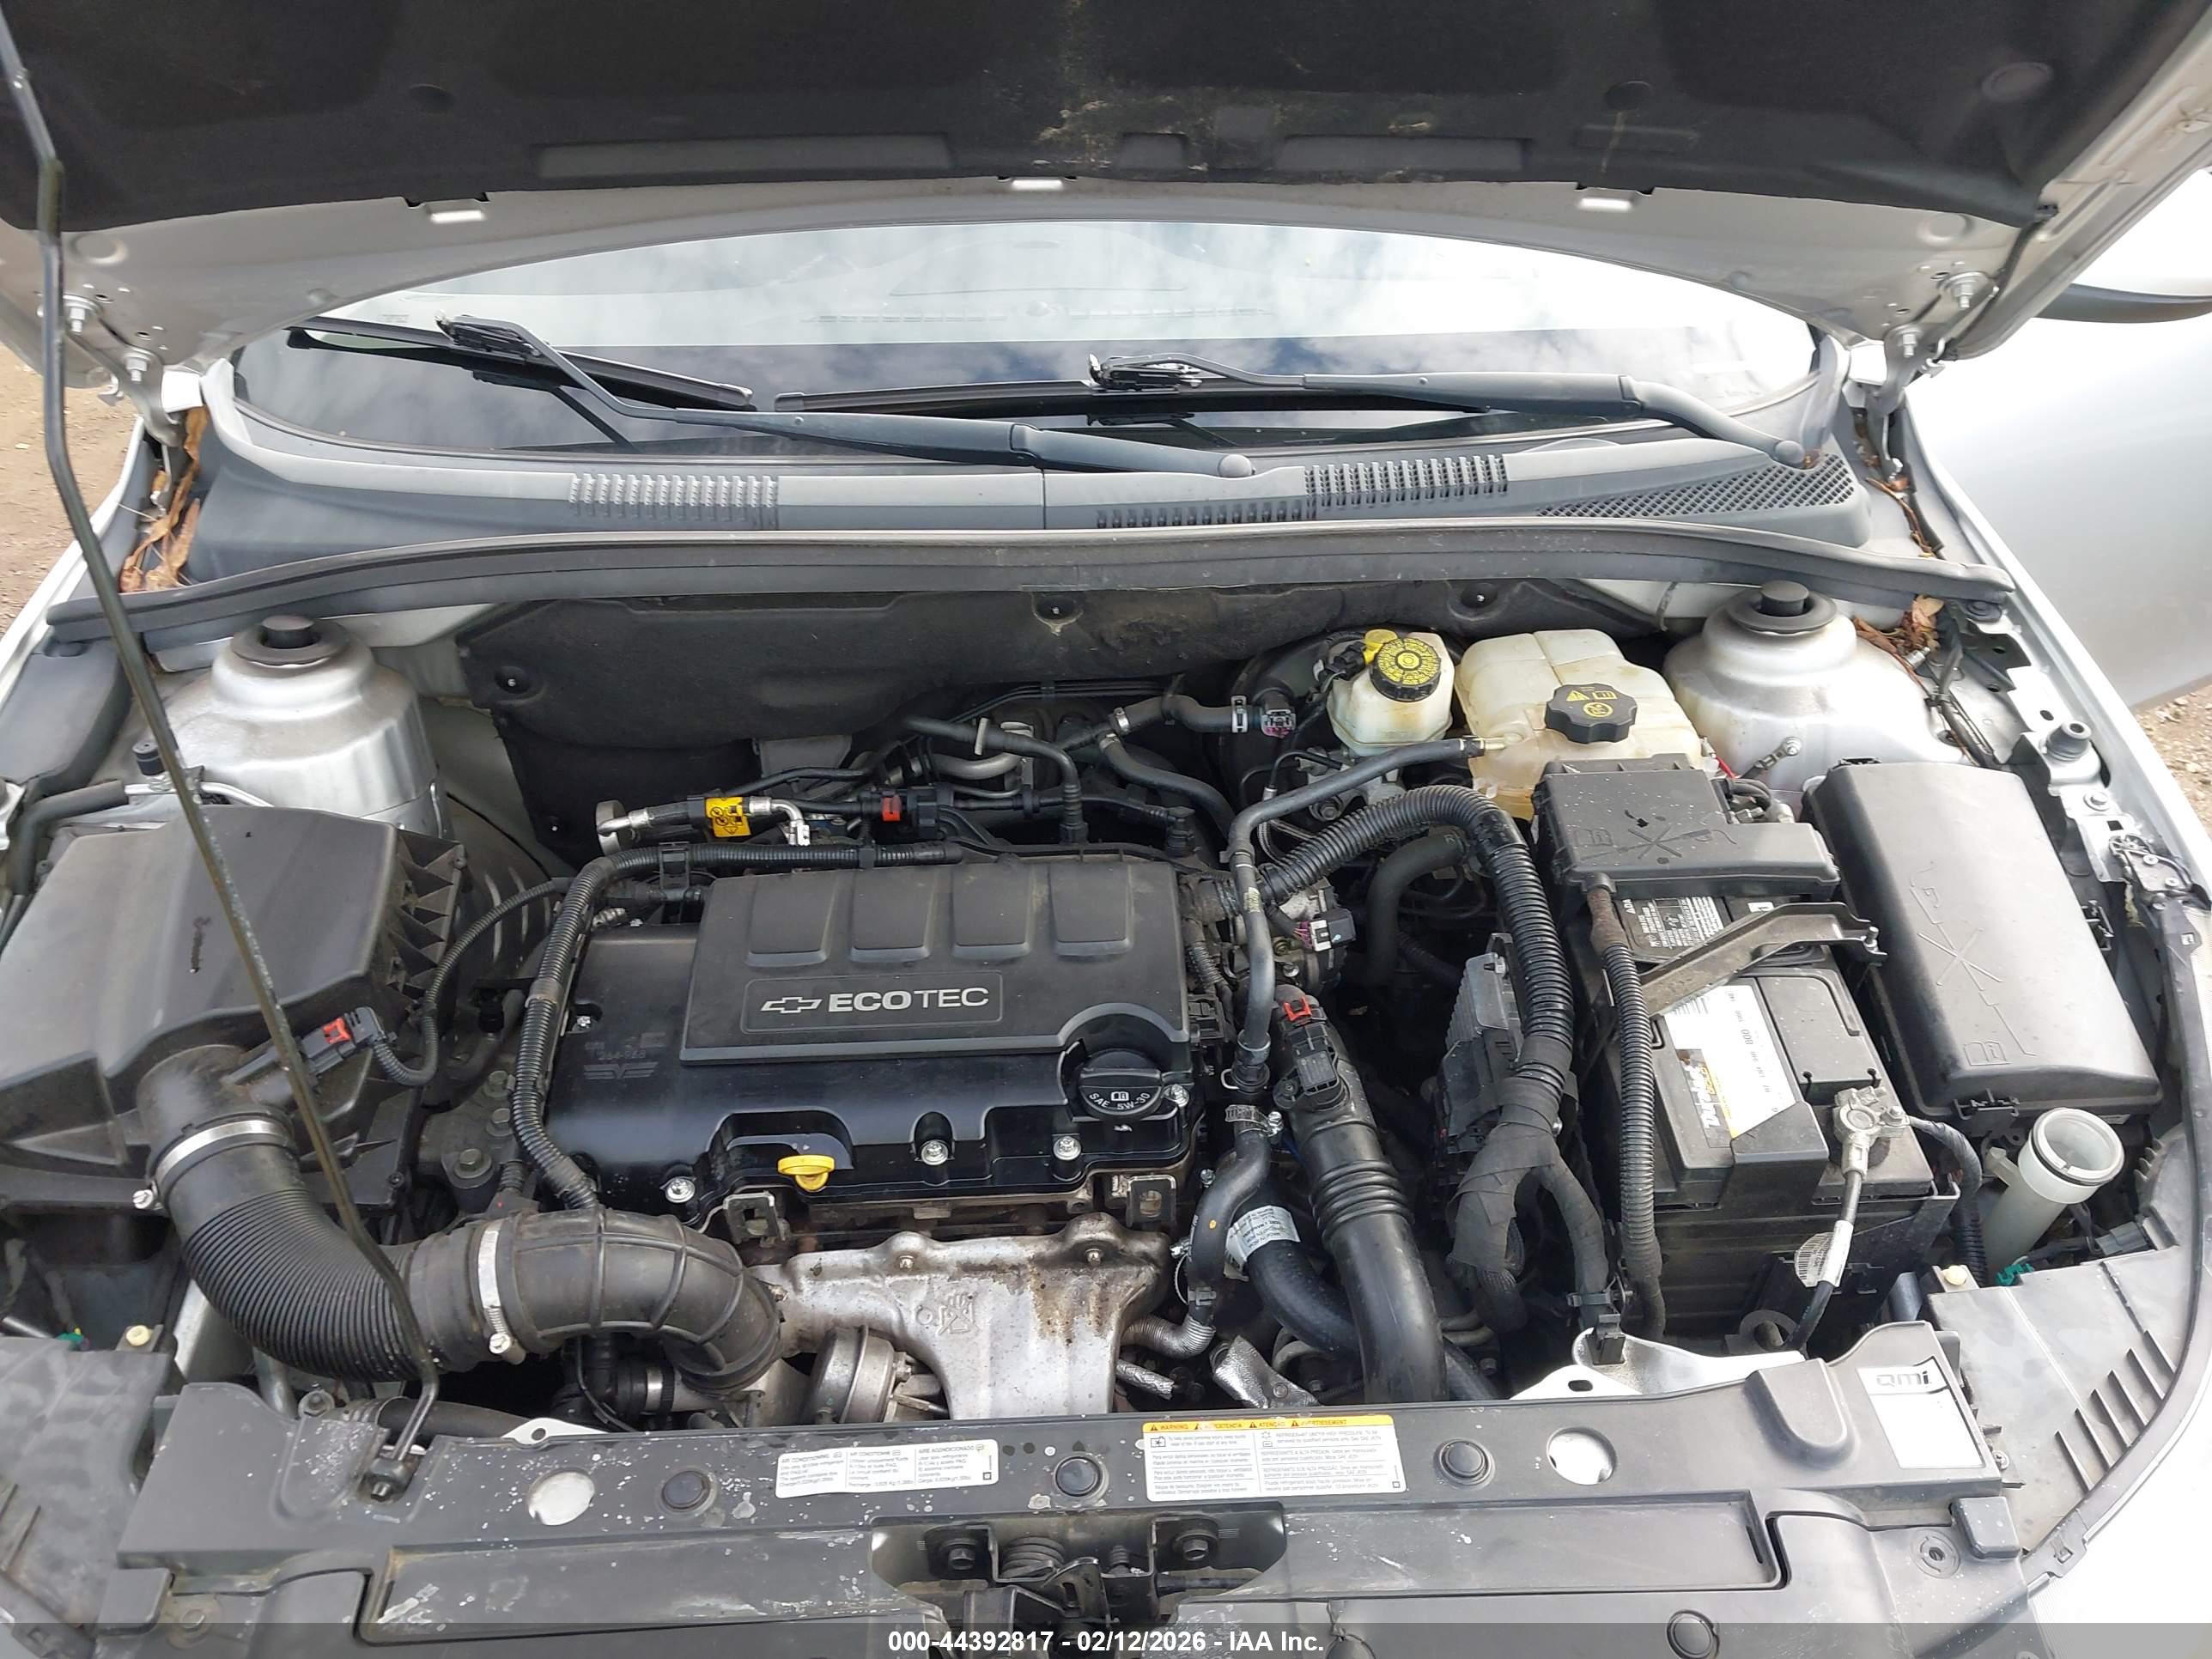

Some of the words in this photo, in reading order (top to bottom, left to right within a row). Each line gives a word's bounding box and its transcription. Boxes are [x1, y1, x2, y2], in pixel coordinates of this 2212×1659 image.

[828, 987, 990, 1013] ECOTEC
[1089, 1092, 1110, 1109] SAE
[1116, 1092, 1151, 1110] 5W-30
